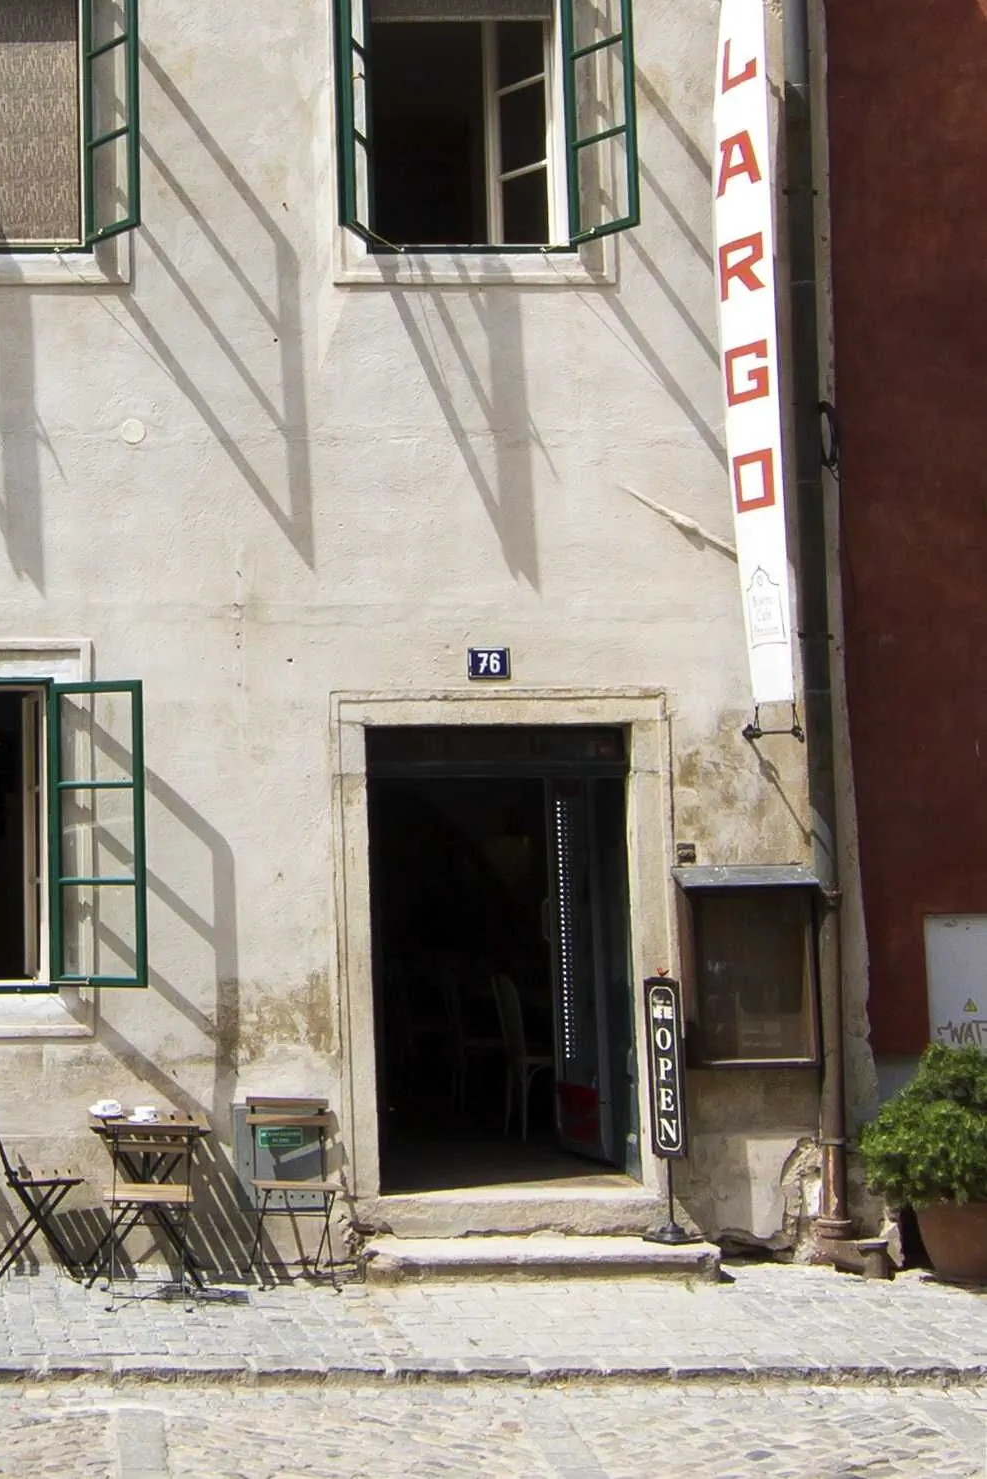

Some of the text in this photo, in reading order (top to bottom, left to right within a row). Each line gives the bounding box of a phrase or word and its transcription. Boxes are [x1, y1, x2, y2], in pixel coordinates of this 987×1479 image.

[716, 38, 776, 513] LARGO
[477, 652, 501, 674] 76
[655, 1027, 677, 1142] OPEN
